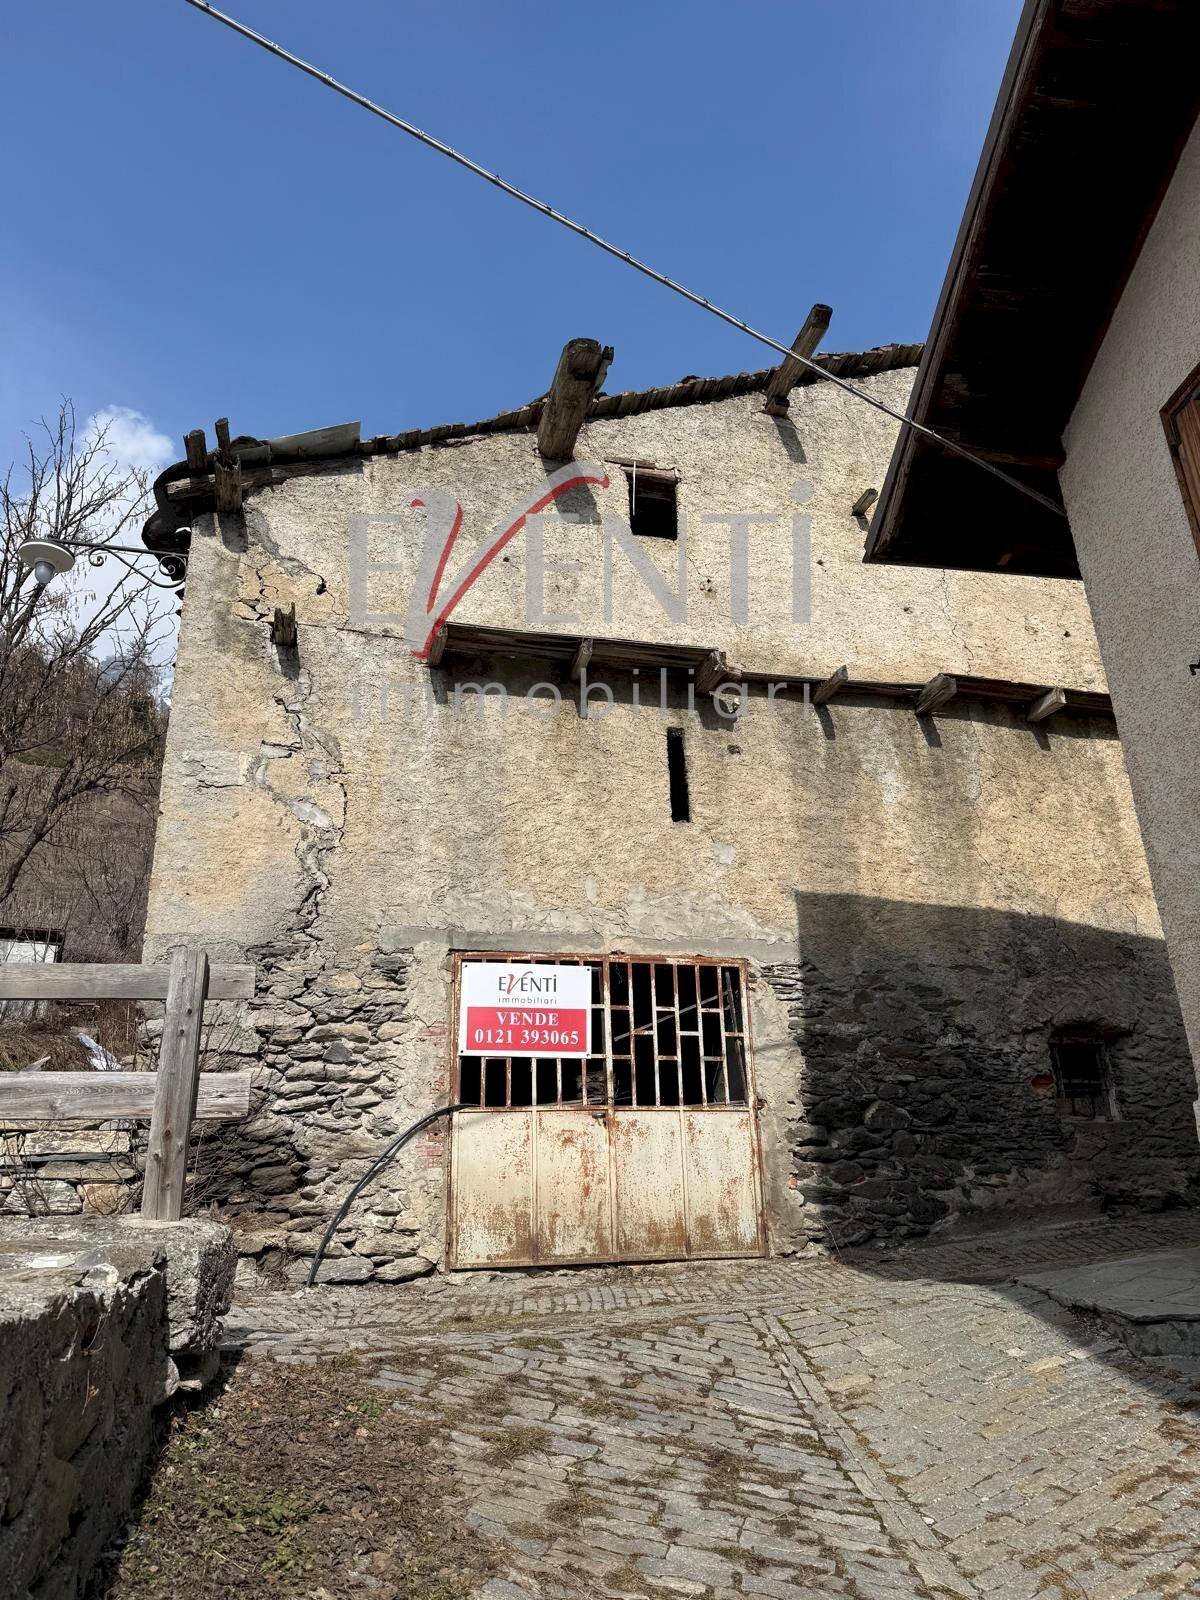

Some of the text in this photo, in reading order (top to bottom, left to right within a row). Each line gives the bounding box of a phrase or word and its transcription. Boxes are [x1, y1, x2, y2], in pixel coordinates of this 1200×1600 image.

[498, 996, 557, 1005] immobiliari
[495, 1011, 559, 1026] VENDE
[474, 1028, 579, 1045] 0121 393065
